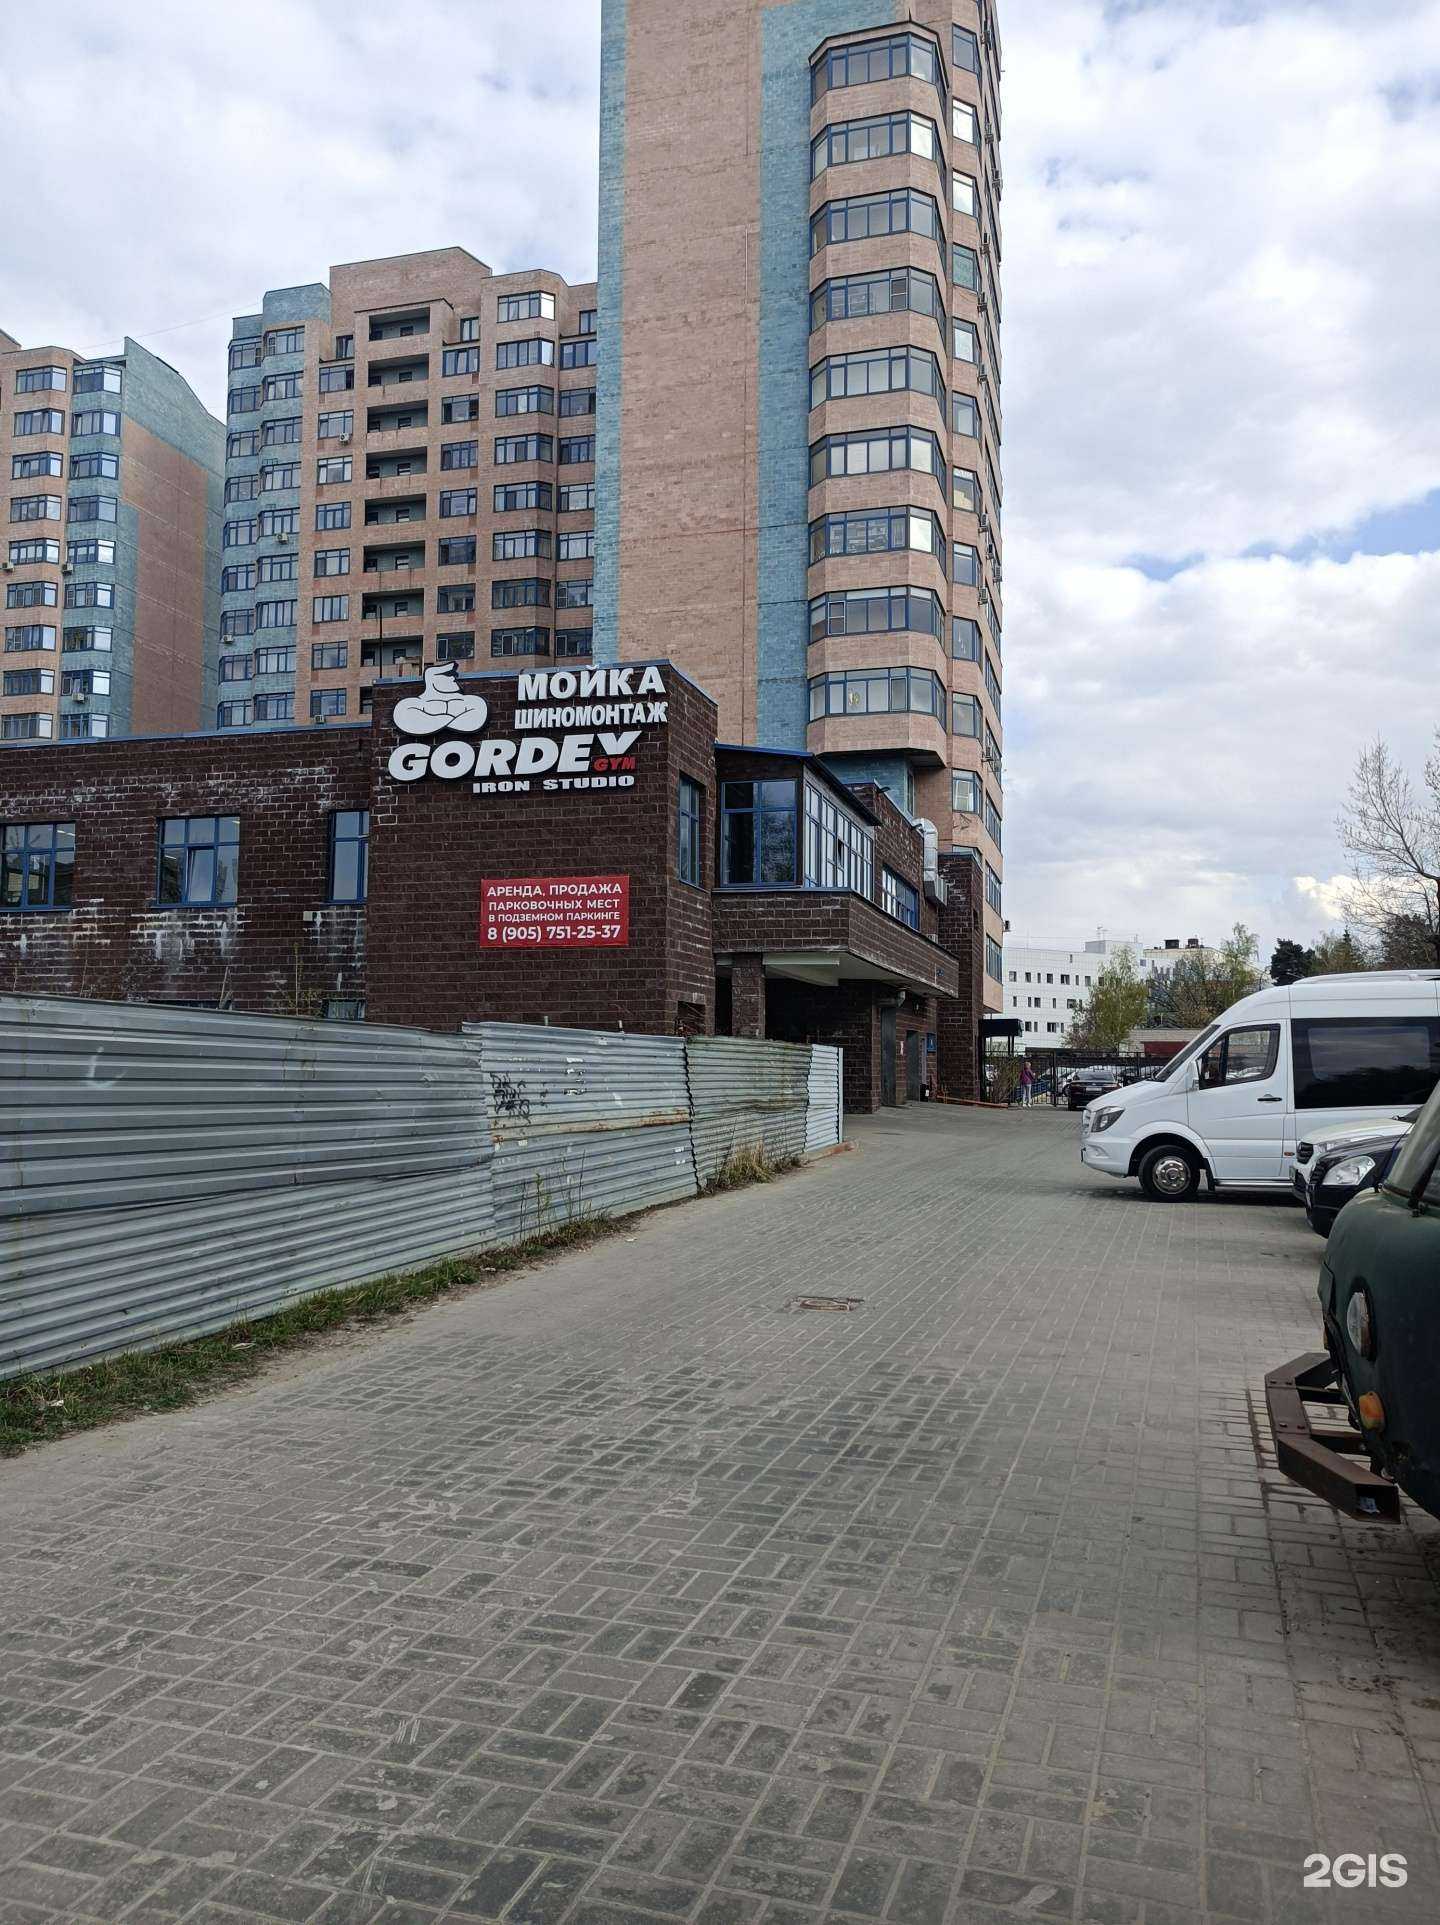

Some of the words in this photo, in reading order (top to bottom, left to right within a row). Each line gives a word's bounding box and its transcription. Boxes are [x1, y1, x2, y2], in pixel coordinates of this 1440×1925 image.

[518, 664, 667, 701] МОЙКА
[515, 701, 669, 730] ШИНОМОНТАЖ
[388, 730, 643, 782] GORDEY
[592, 755, 636, 773] GYM
[472, 779, 530, 794] IRON
[543, 775, 635, 790] STUDIO
[549, 883, 622, 896] ПРОДАЖА
[489, 900, 583, 911] ПАРКОВОЧНЫХ
[587, 899, 620, 909] МЕСТ
[488, 914, 496, 922] В
[498, 913, 563, 923] ПОДЗЕМНОМ
[566, 911, 620, 921] ПАРКИНГЕ
[487, 927, 498, 940] 8
[502, 925, 542, 943] (905)
[546, 925, 621, 940] 751-25-37
